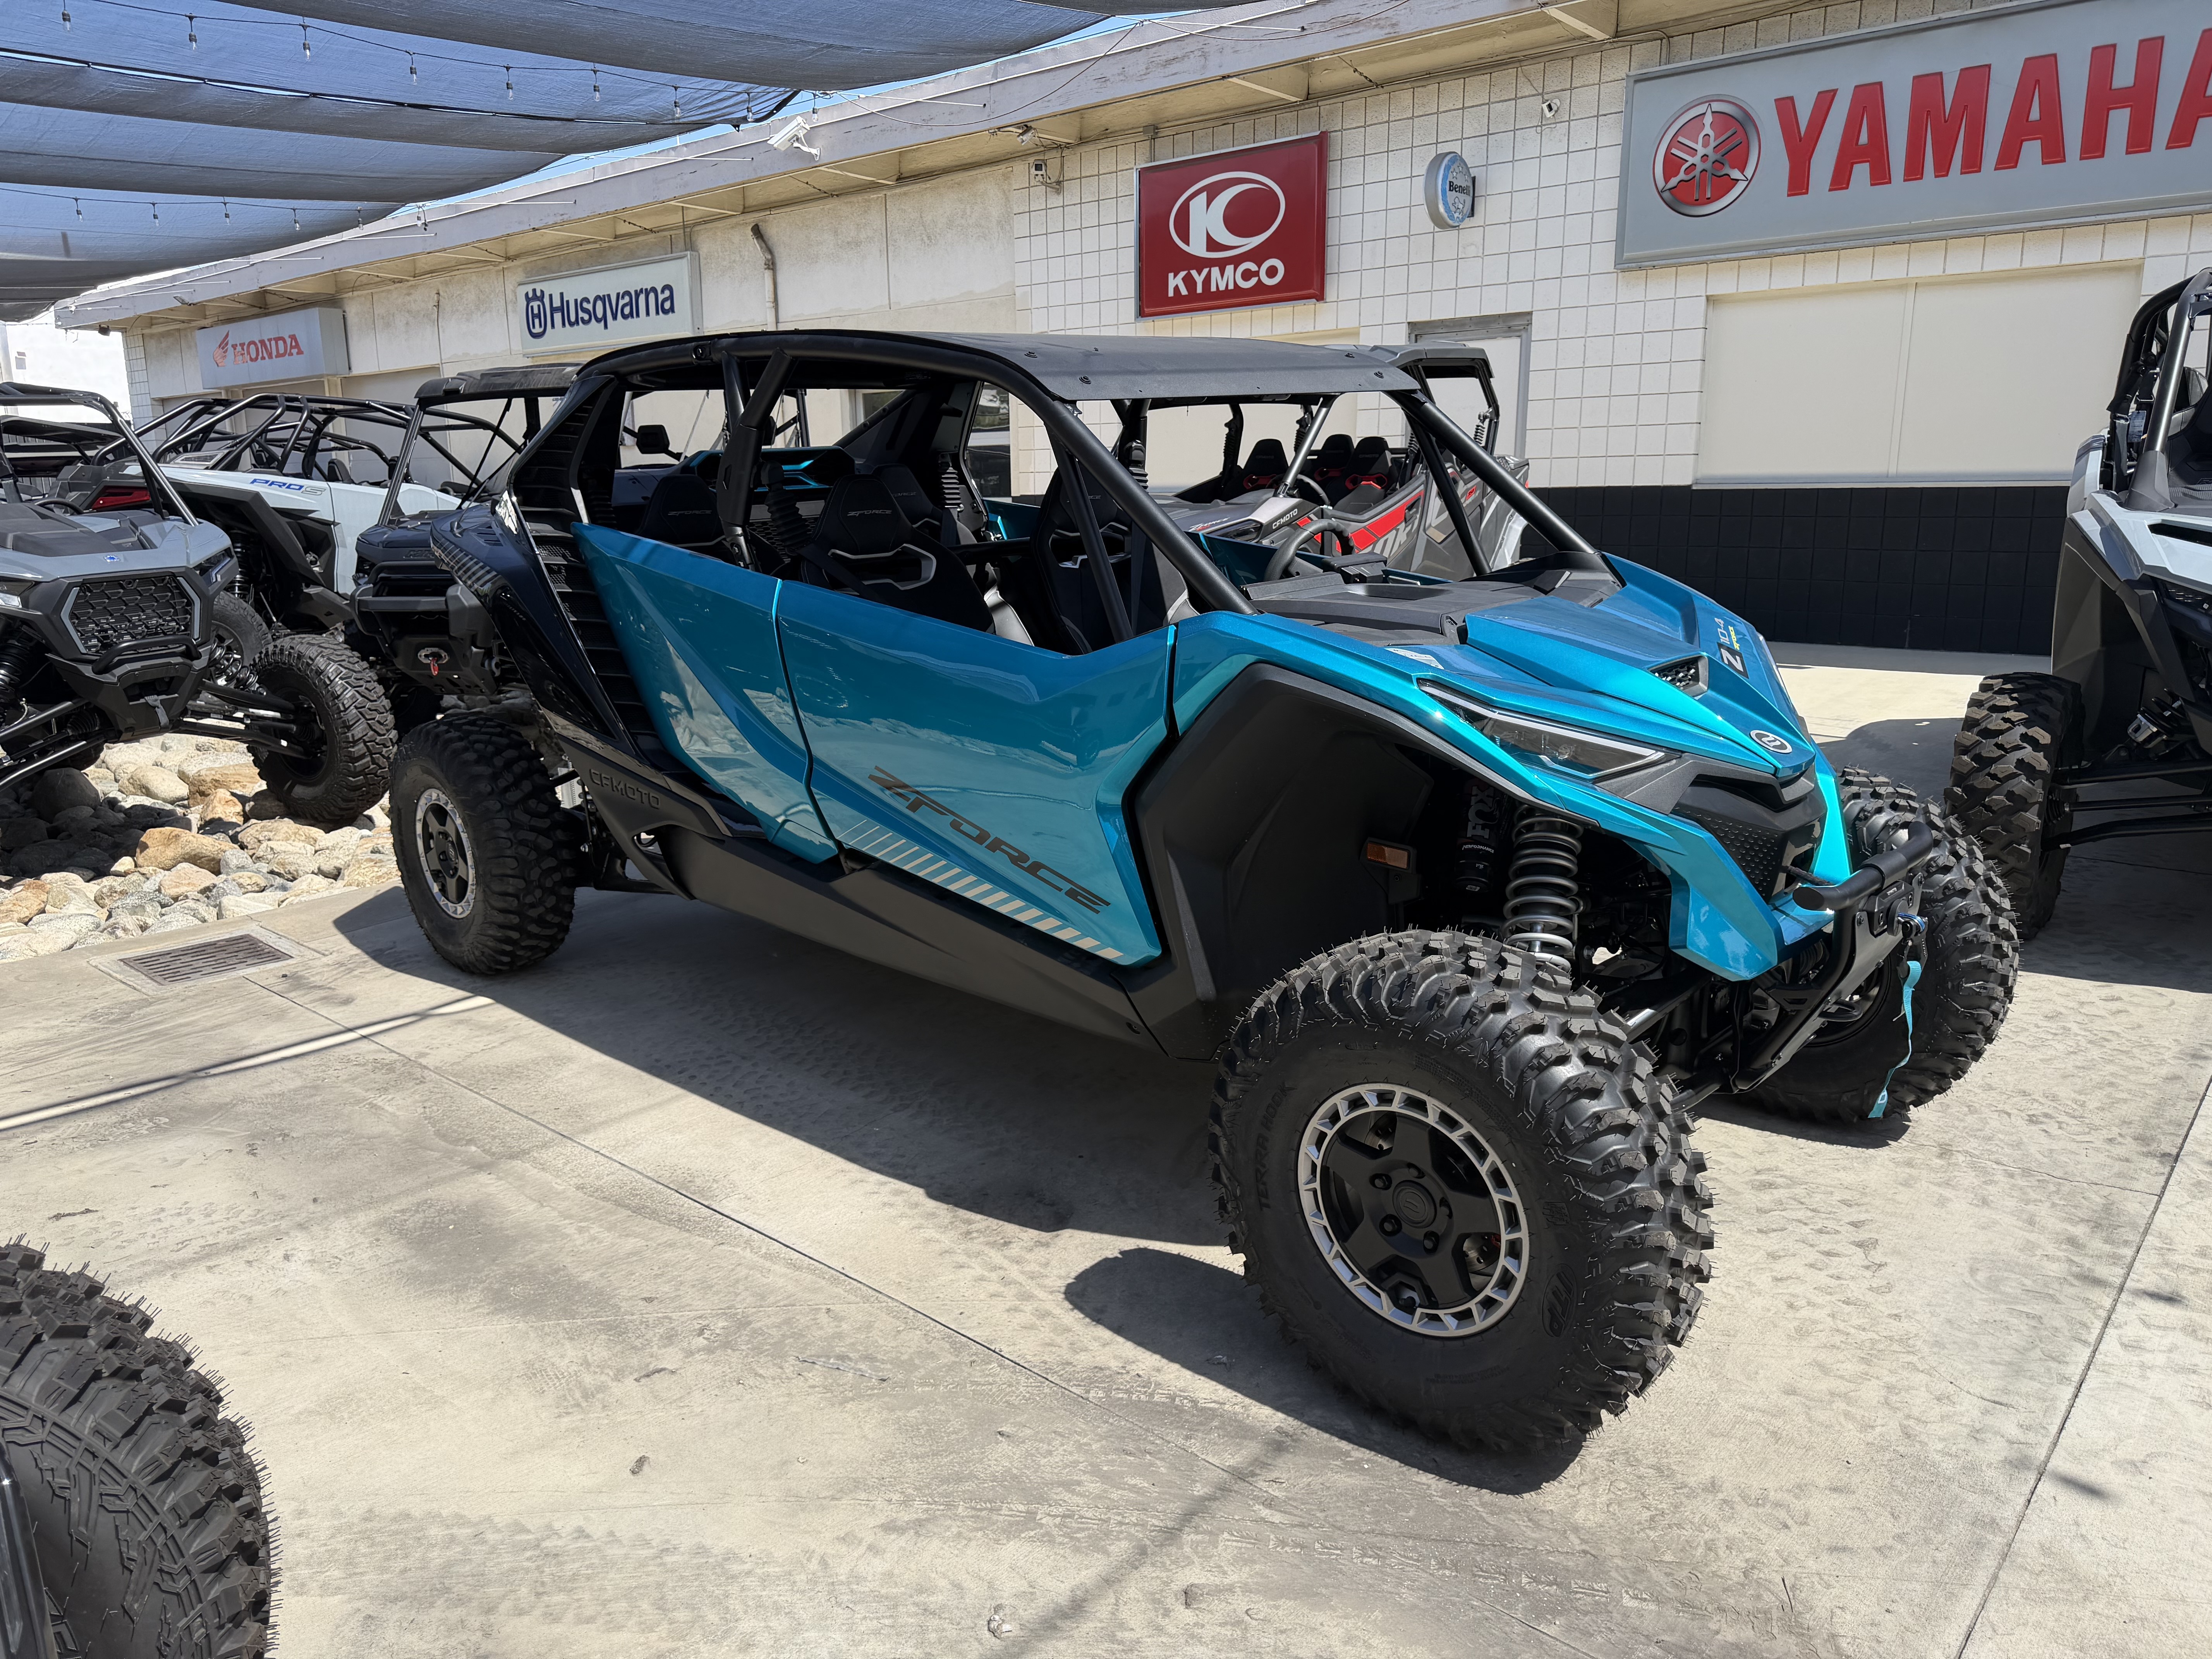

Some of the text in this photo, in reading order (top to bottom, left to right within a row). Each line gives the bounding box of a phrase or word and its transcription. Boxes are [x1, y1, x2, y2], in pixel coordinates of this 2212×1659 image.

[1449, 181, 1471, 196] Benelli
[1168, 258, 1285, 297] KYMCO
[548, 284, 675, 330] Husqvarna
[231, 334, 304, 365] HONDA
[250, 478, 327, 496] PRO S
[1272, 508, 1298, 530] CFMOTO
[589, 768, 661, 810] CFMOTO
[1467, 786, 1494, 839] FOX
[867, 765, 1111, 914] ZFORCE
[1255, 1081, 1296, 1211] TERRA HOOK
